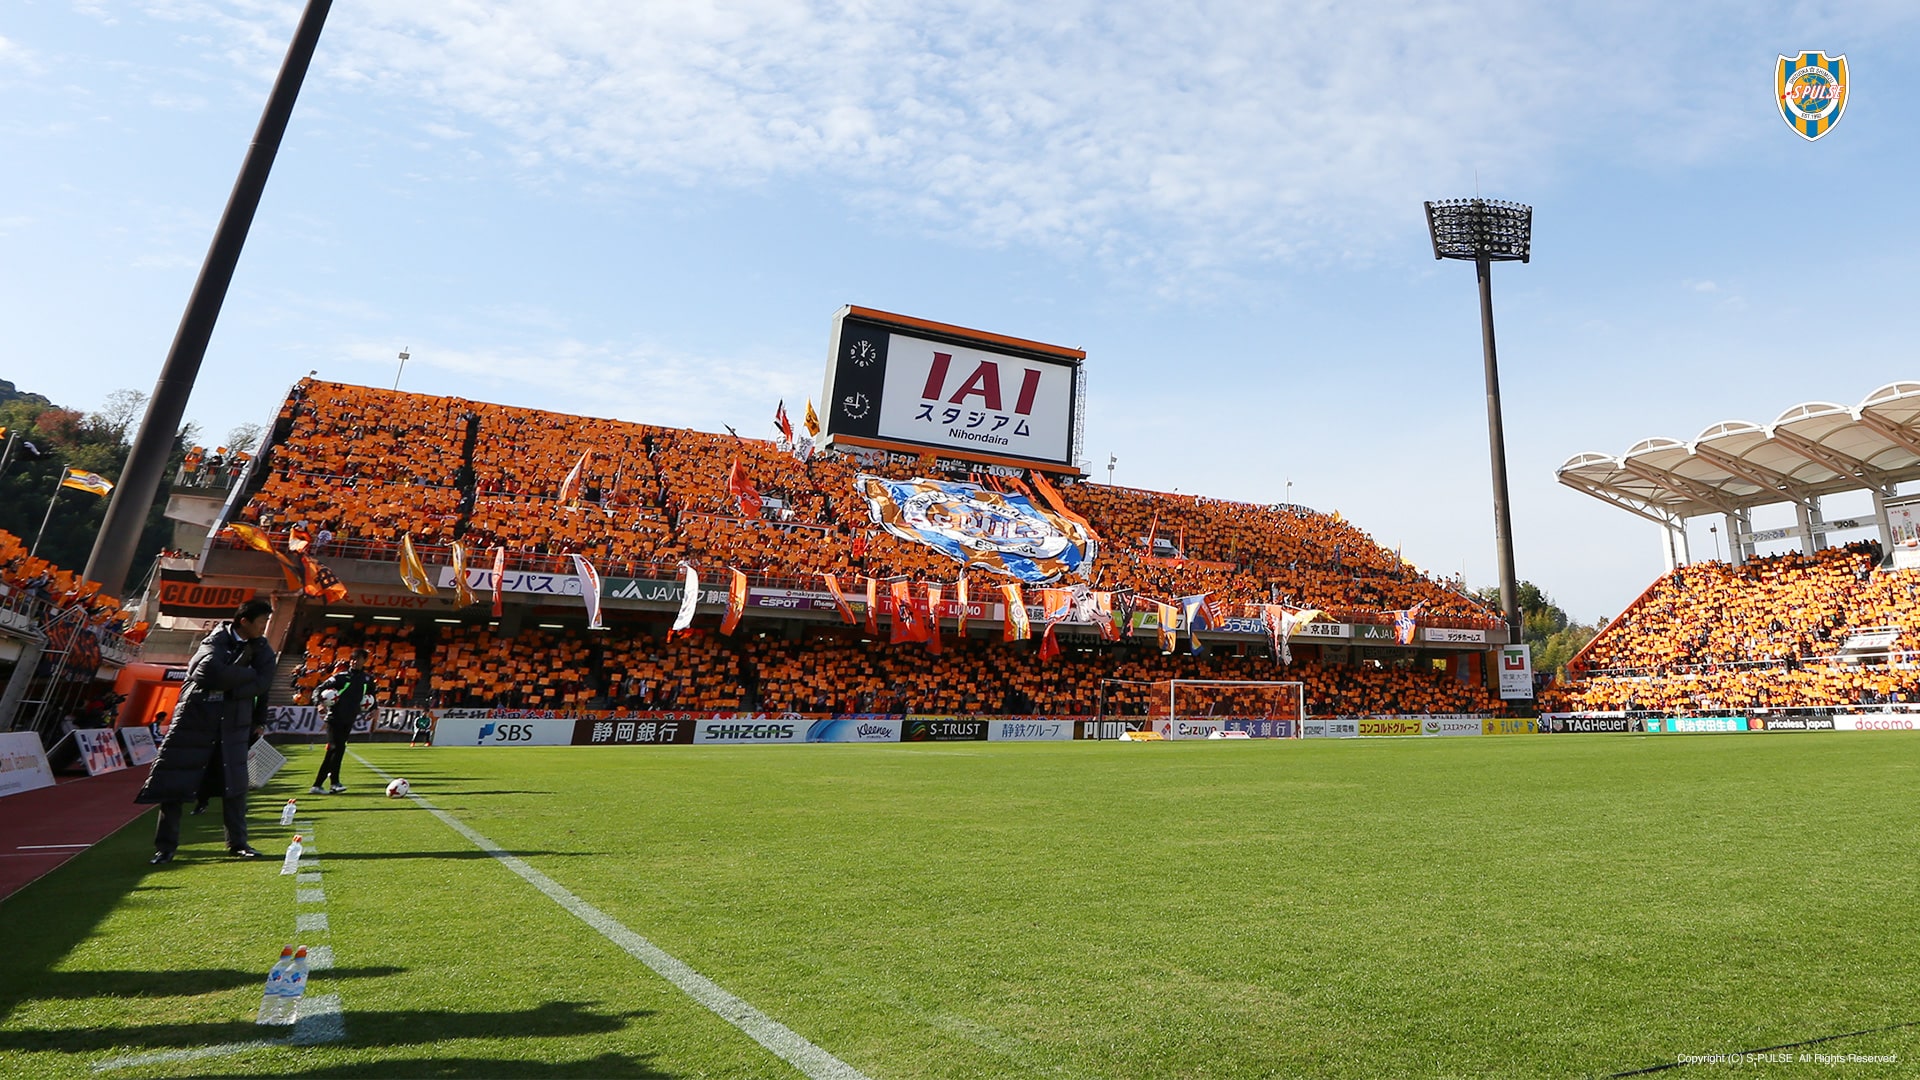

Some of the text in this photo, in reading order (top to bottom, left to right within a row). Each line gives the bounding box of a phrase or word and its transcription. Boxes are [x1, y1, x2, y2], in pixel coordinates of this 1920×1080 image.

[921, 351, 1042, 416] IAI
[915, 404, 1031, 437] スタジアム
[948, 428, 1009, 446] Nihondaira
[163, 584, 245, 605] CLOUD9
[857, 724, 892, 739] Kleenex
[930, 723, 980, 736] S-TRUST
[1001, 724, 1060, 739] 静鉄グループ
[1084, 721, 1126, 739] PUMA
[1329, 724, 1355, 733] 三菱電機
[1359, 722, 1420, 735] コンコルドグループ
[1675, 719, 1737, 732] 明治安田生命
[1855, 718, 1913, 731] docomo
[495, 725, 533, 742] SBS
[593, 722, 678, 743] 静岡銀行
[705, 725, 794, 740] SHIZGAS
